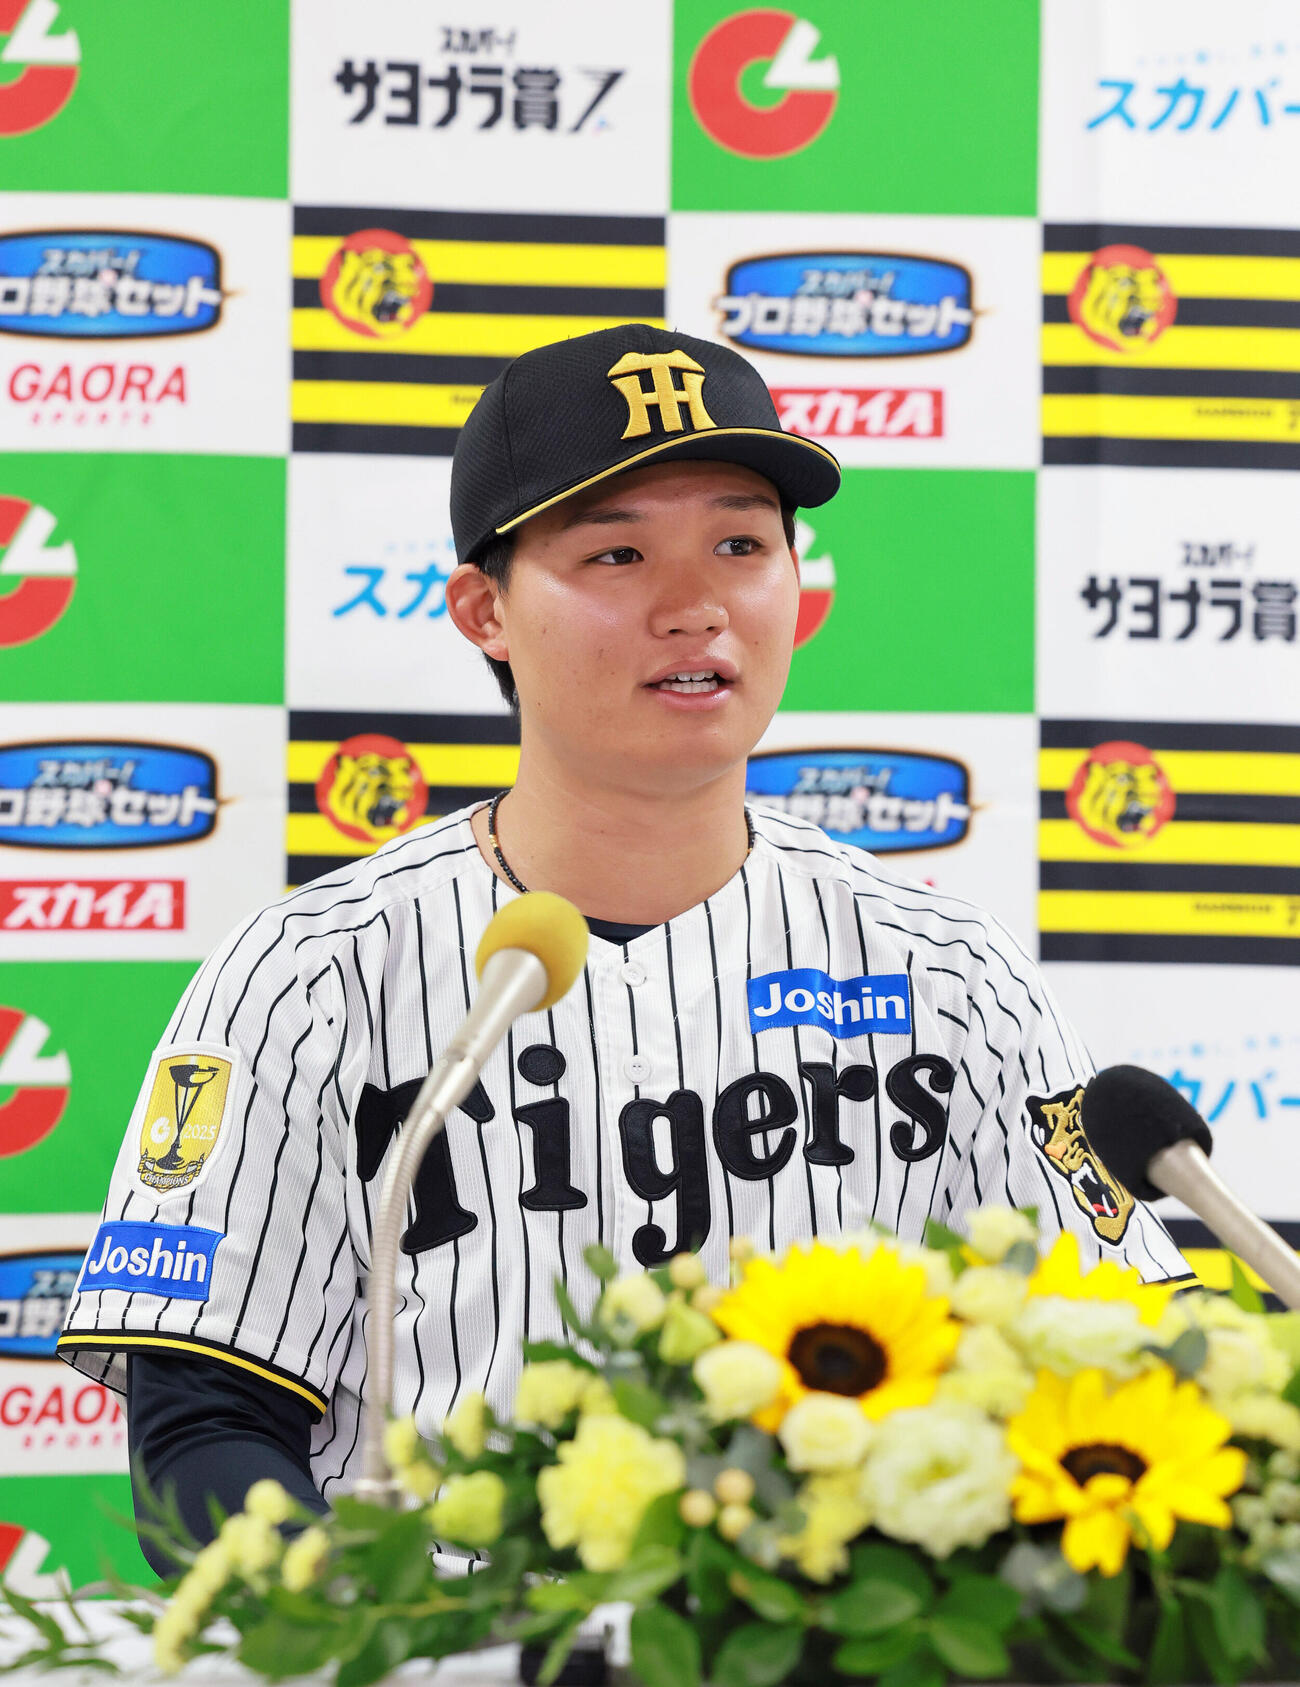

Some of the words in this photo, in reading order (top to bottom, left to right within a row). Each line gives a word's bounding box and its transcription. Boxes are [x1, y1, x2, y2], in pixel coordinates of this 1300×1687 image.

[334, 60, 560, 131] サヨナラ賞
[8, 363, 189, 404] GAORA
[1080, 576, 1298, 642] サヨナラ賞
[753, 982, 906, 1025] Joshin
[183, 1123, 217, 1141] 2025
[356, 1043, 955, 1268] Tigers
[143, 1173, 192, 1187] CHAMPIONS
[88, 1235, 207, 1283] Joshin
